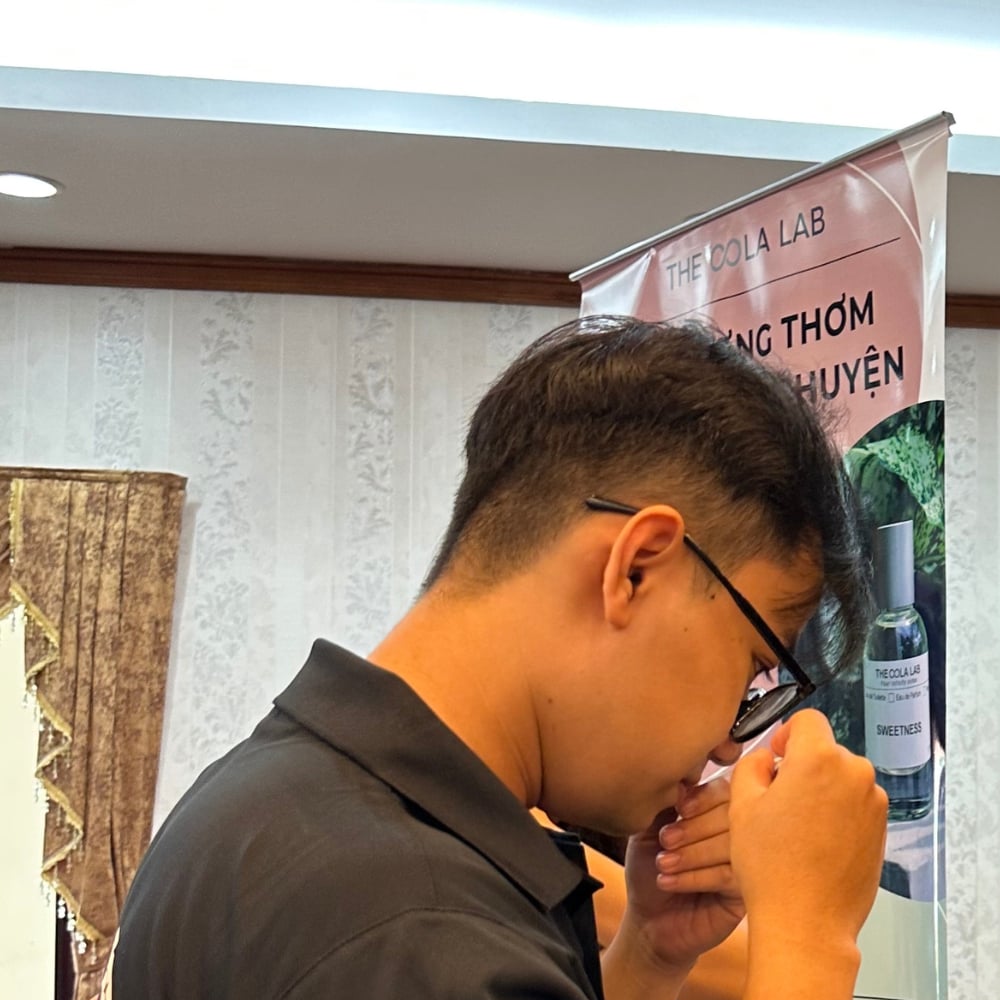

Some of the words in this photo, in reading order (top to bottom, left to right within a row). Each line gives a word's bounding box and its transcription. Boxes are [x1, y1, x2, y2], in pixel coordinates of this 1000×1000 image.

[666, 252, 702, 290] THE
[710, 227, 770, 272] COLA
[780, 206, 825, 247] LAB
[728, 324, 771, 357] NG
[781, 290, 874, 348] THƠM
[875, 668, 888, 679] THE
[909, 664, 921, 676] LAB
[876, 721, 922, 736] SWEETNESS
